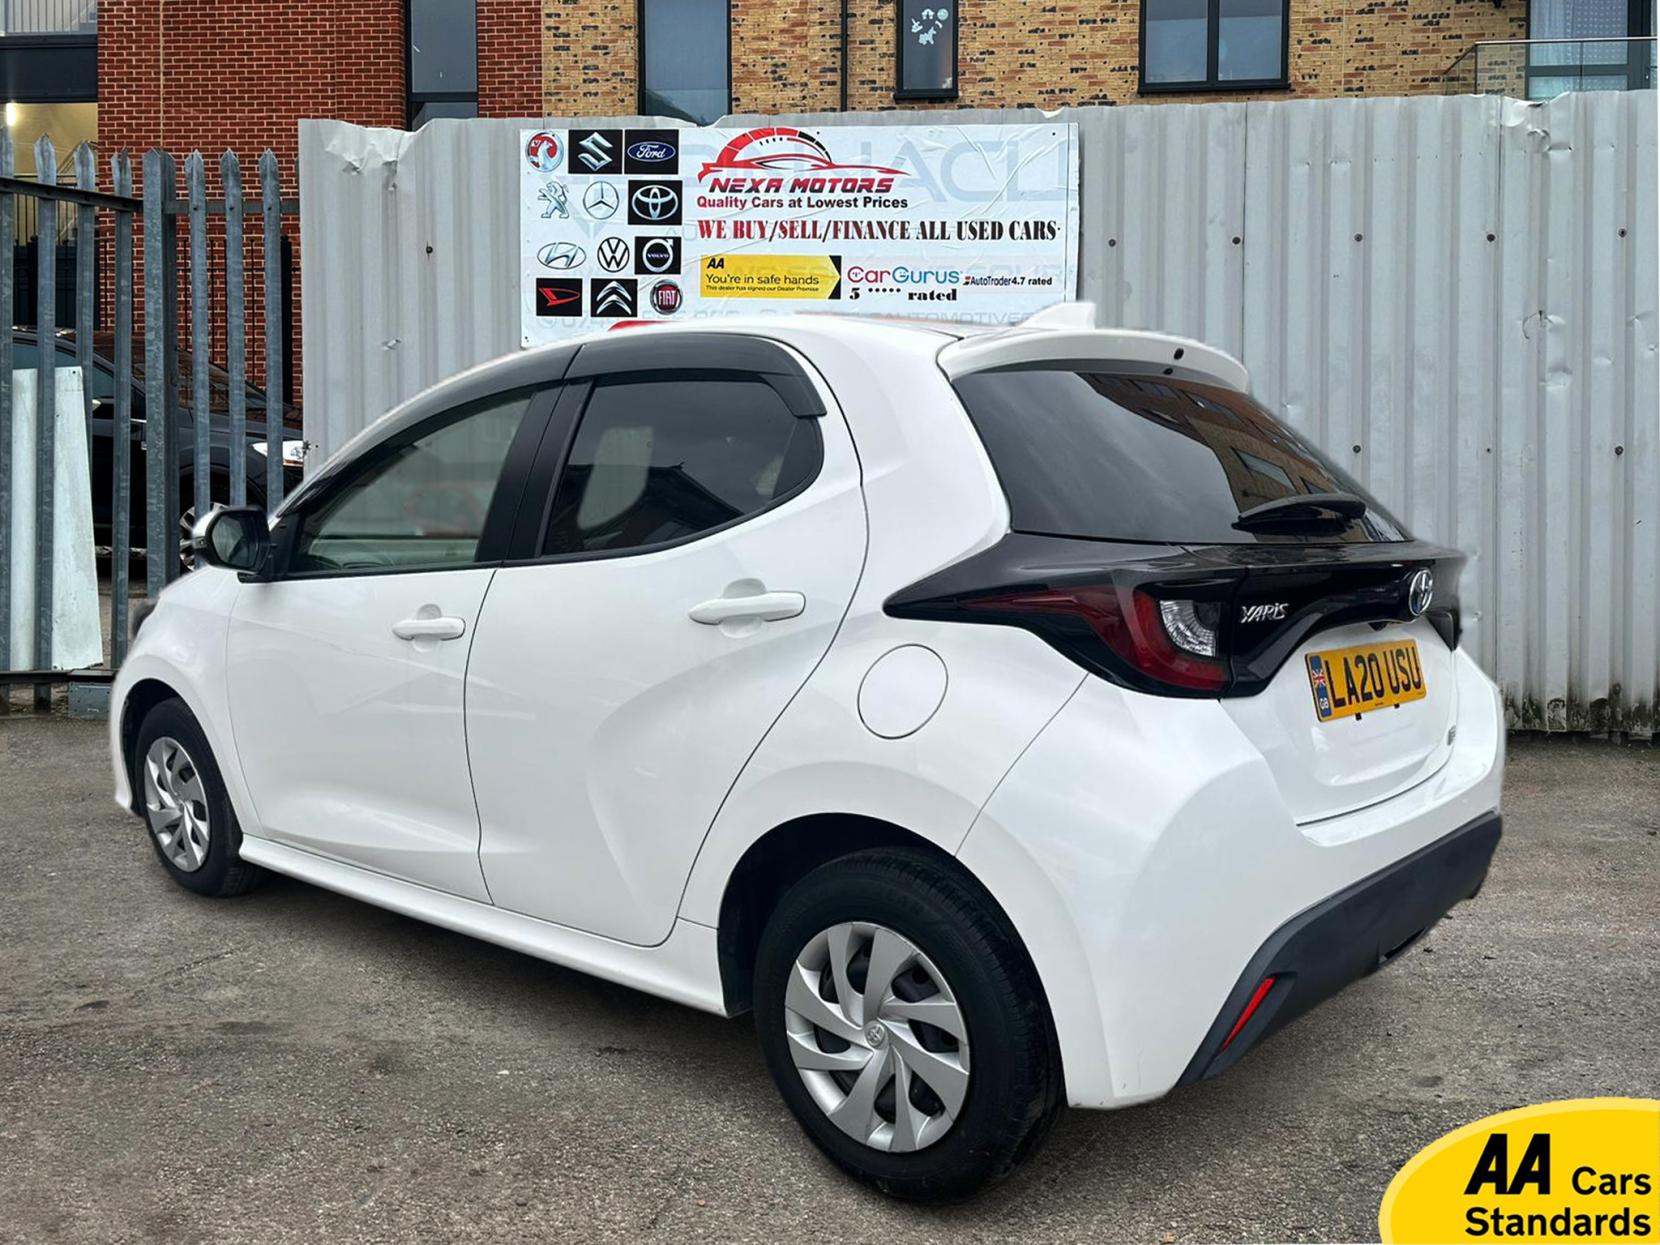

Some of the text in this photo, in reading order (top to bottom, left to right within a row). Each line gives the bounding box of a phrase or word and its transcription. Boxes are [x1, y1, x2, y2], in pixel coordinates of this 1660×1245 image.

[636, 144, 666, 158] Ford
[709, 178, 895, 193] NEXA MOTORS
[697, 196, 908, 210] Quality Cars at Lowest Prices
[697, 220, 726, 240] WE
[916, 220, 950, 241] ALL
[956, 220, 1003, 241] USED
[1008, 220, 1057, 241] CARS
[706, 257, 724, 269] AA
[705, 274, 820, 285] You're in safe hands
[847, 266, 960, 284] CarGurus
[1028, 276, 1052, 285] rated
[658, 290, 677, 306] FIAT
[849, 287, 957, 300] 5 rated
[1325, 646, 1422, 708] LA20 USU
